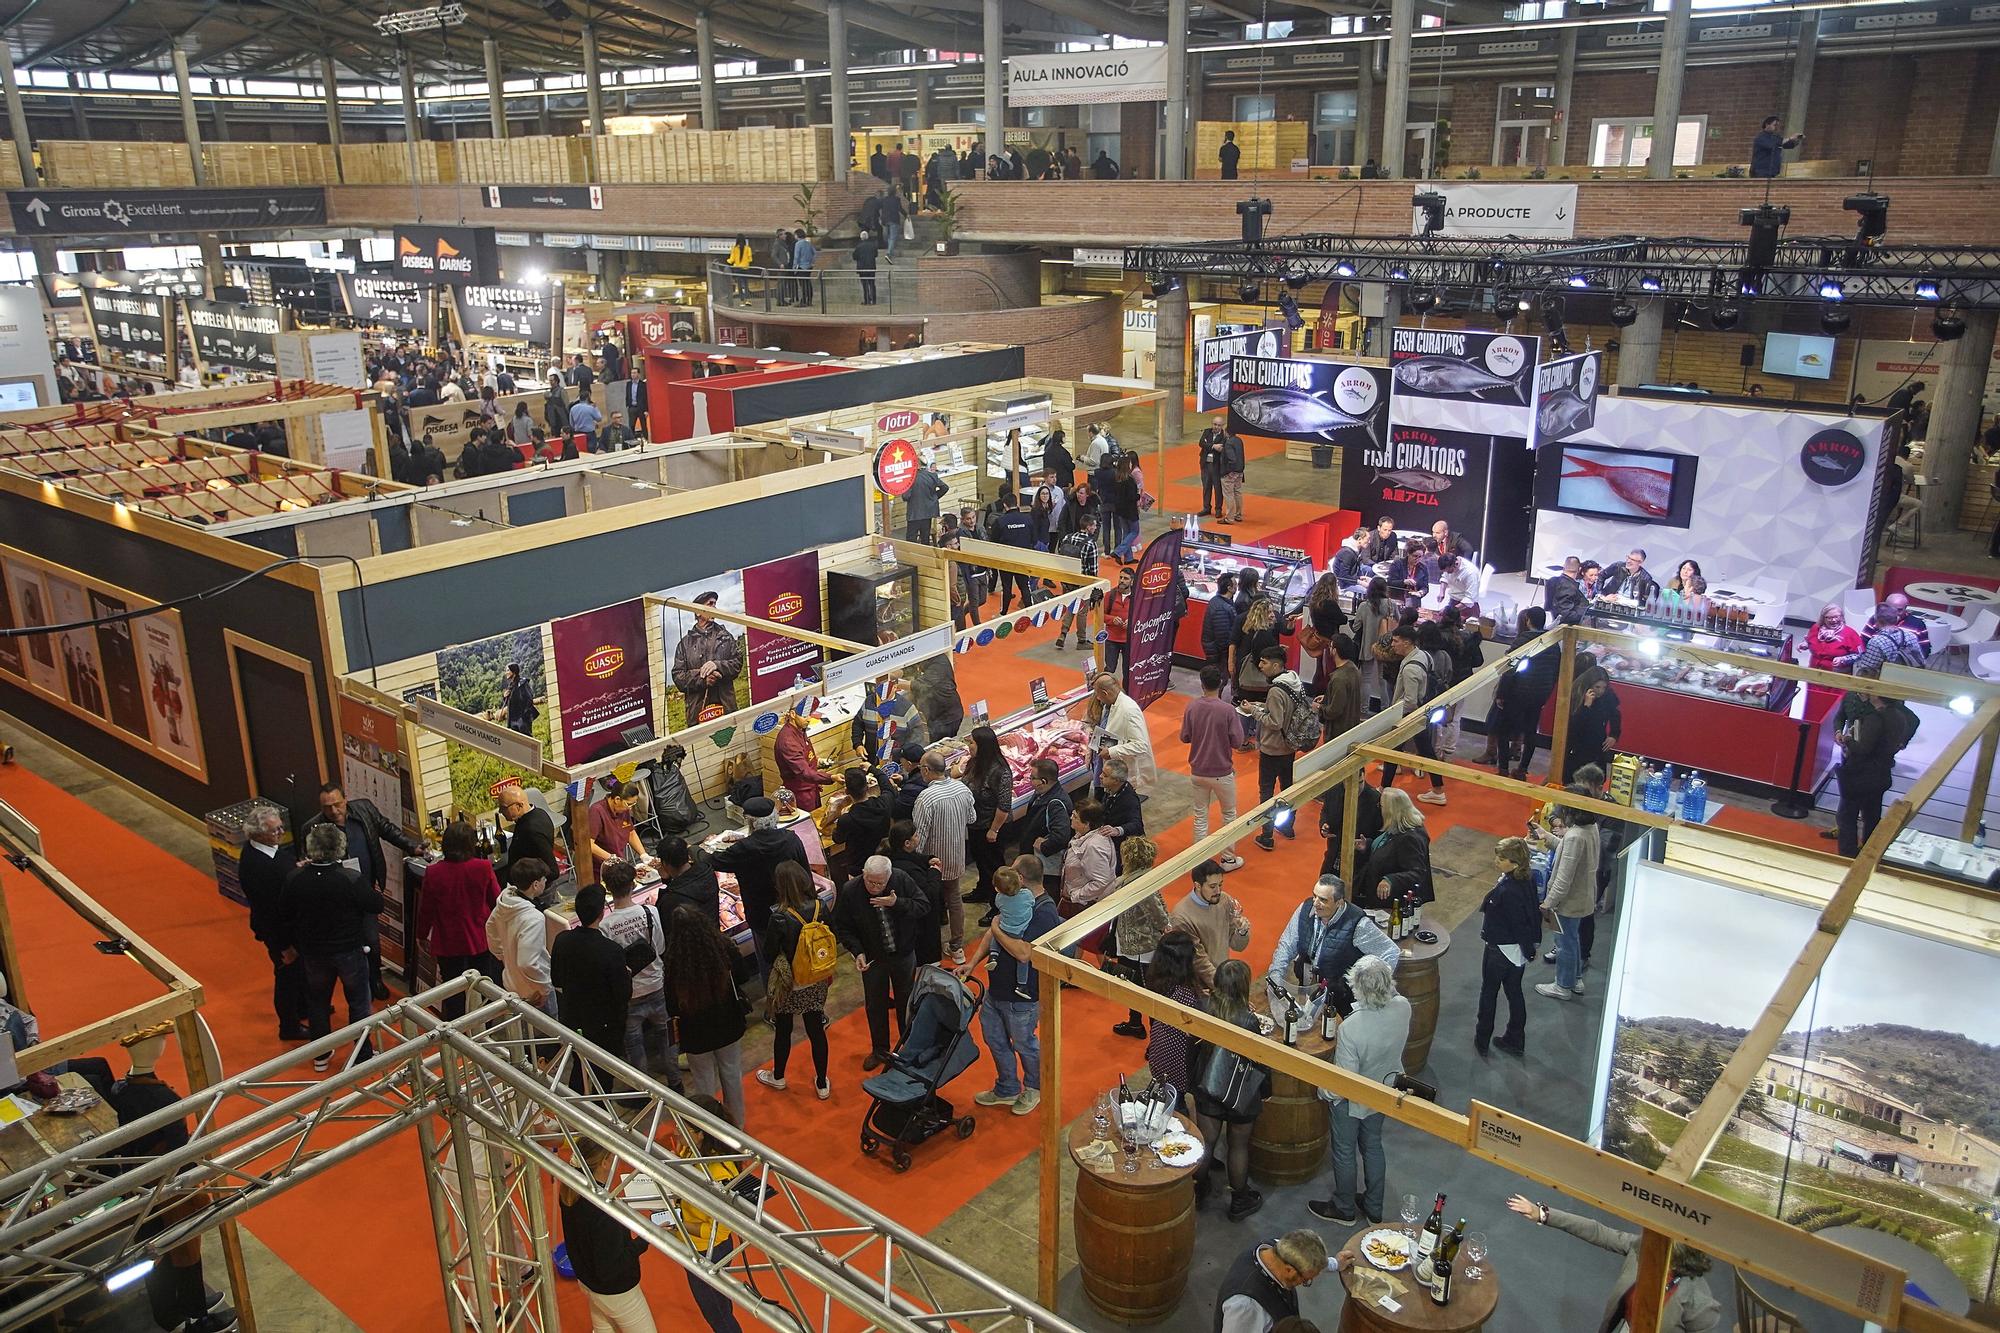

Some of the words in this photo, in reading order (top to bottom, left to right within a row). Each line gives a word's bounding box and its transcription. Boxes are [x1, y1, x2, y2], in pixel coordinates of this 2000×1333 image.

[1013, 69, 1048, 82] AULA
[1051, 60, 1129, 80] INNOVACIÓ
[61, 206, 101, 218] Girona
[1458, 207, 1531, 219] PRODUCTE
[402, 255, 434, 269] DISBESA
[439, 257, 472, 272] DARNÉS
[641, 320, 665, 341] Tgt
[1205, 341, 1219, 365] FISH
[1394, 330, 1415, 353] FISH
[1416, 332, 1466, 356] CURATORS
[1491, 347, 1520, 357] ARROM
[1232, 359, 1257, 384] FISH
[1257, 361, 1314, 390] CURATORS
[1539, 367, 1550, 394] FISH
[1340, 379, 1372, 391] ARROM
[885, 412, 912, 432] Jotri
[1393, 430, 1439, 446] ARROM
[1396, 442, 1466, 477] CURATORS
[1807, 440, 1860, 459] ARROM
[768, 599, 803, 615] GUASCH
[585, 652, 624, 672] GUASCH
[865, 654, 890, 668] GUASCH
[889, 645, 916, 659] VIANDES
[613, 699, 645, 713] Catalanes
[699, 708, 724, 722] GUASCH
[454, 721, 477, 737] GUASCH
[477, 729, 502, 746] VIANDES
[1621, 1181, 1712, 1226] PIBERNAT
